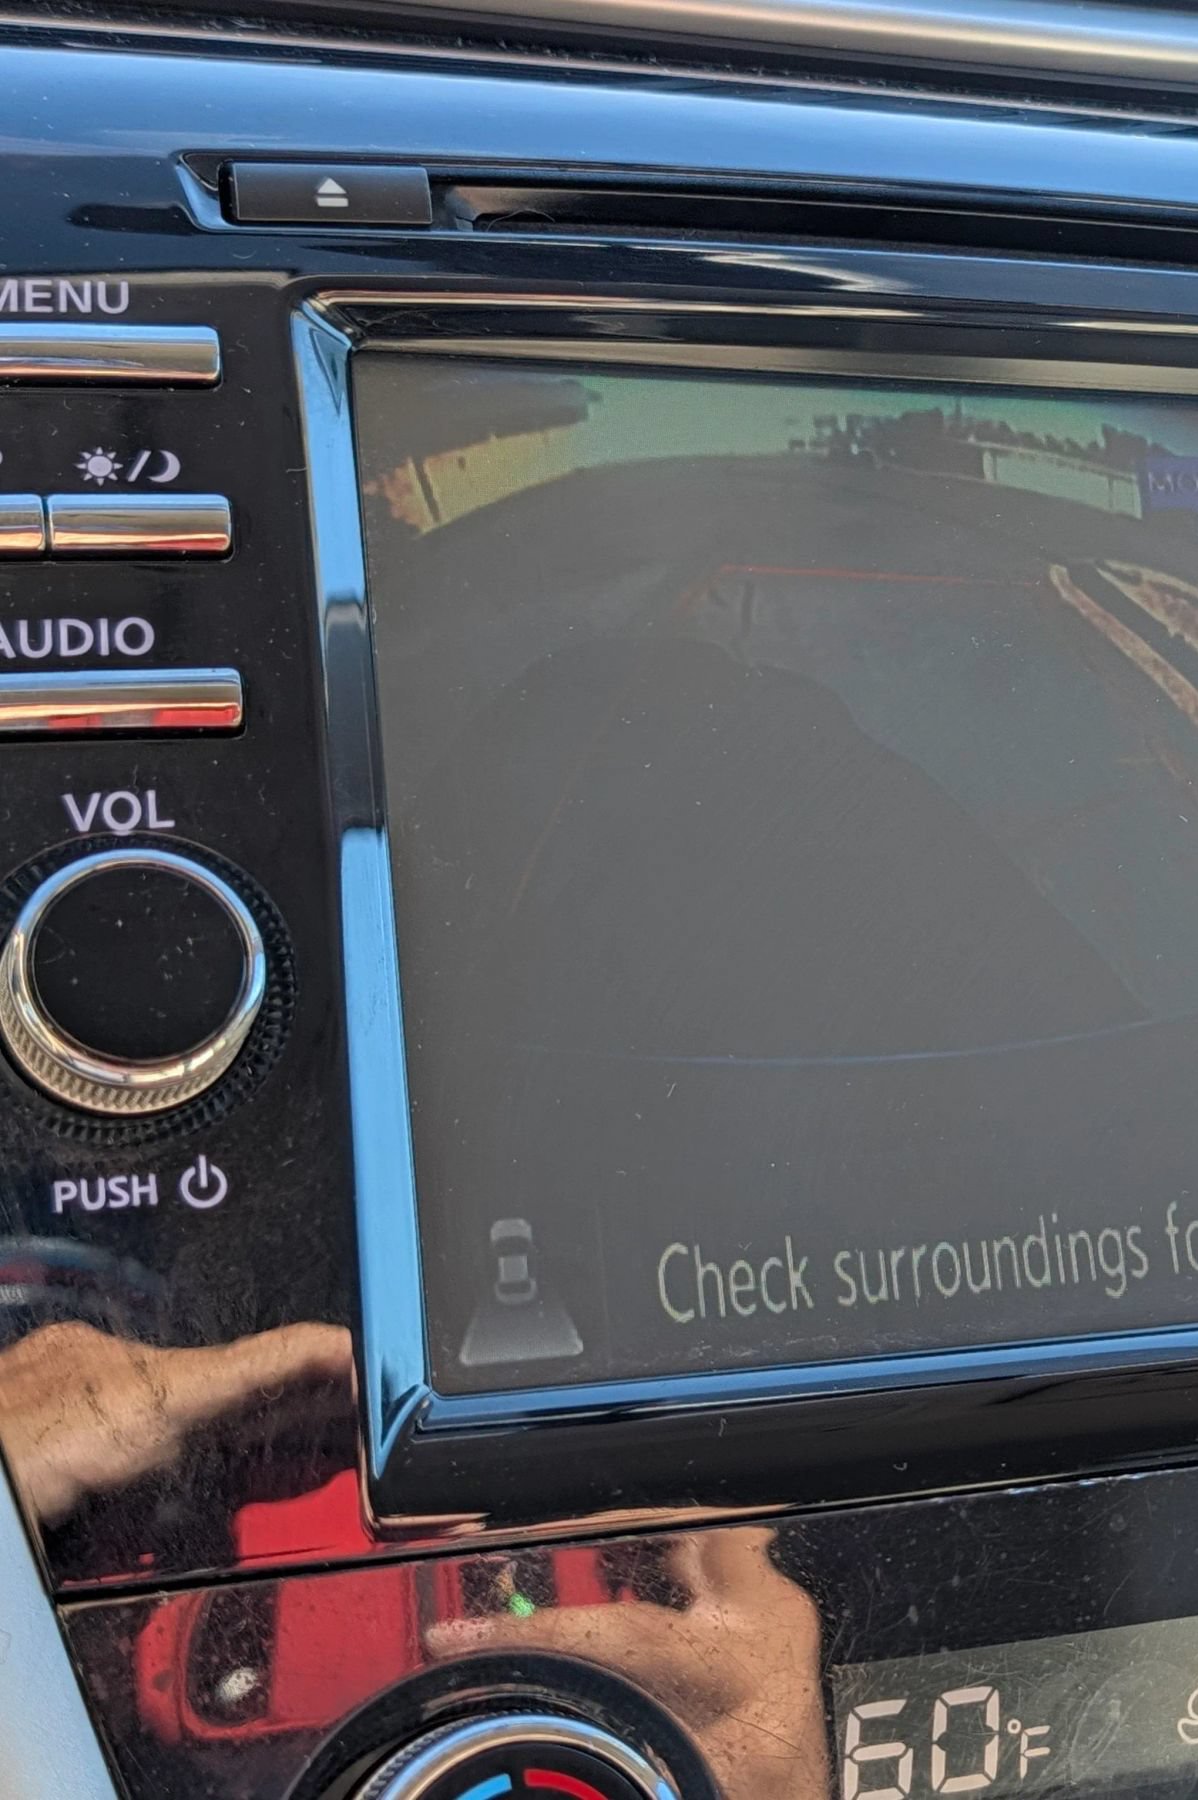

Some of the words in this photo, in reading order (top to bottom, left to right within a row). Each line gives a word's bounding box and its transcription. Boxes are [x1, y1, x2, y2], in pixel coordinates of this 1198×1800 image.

[63, 789, 175, 836] VOL
[52, 1172, 159, 1214] PUSH
[657, 1235, 815, 1324] Check
[833, 1212, 1149, 1306] surroundings
